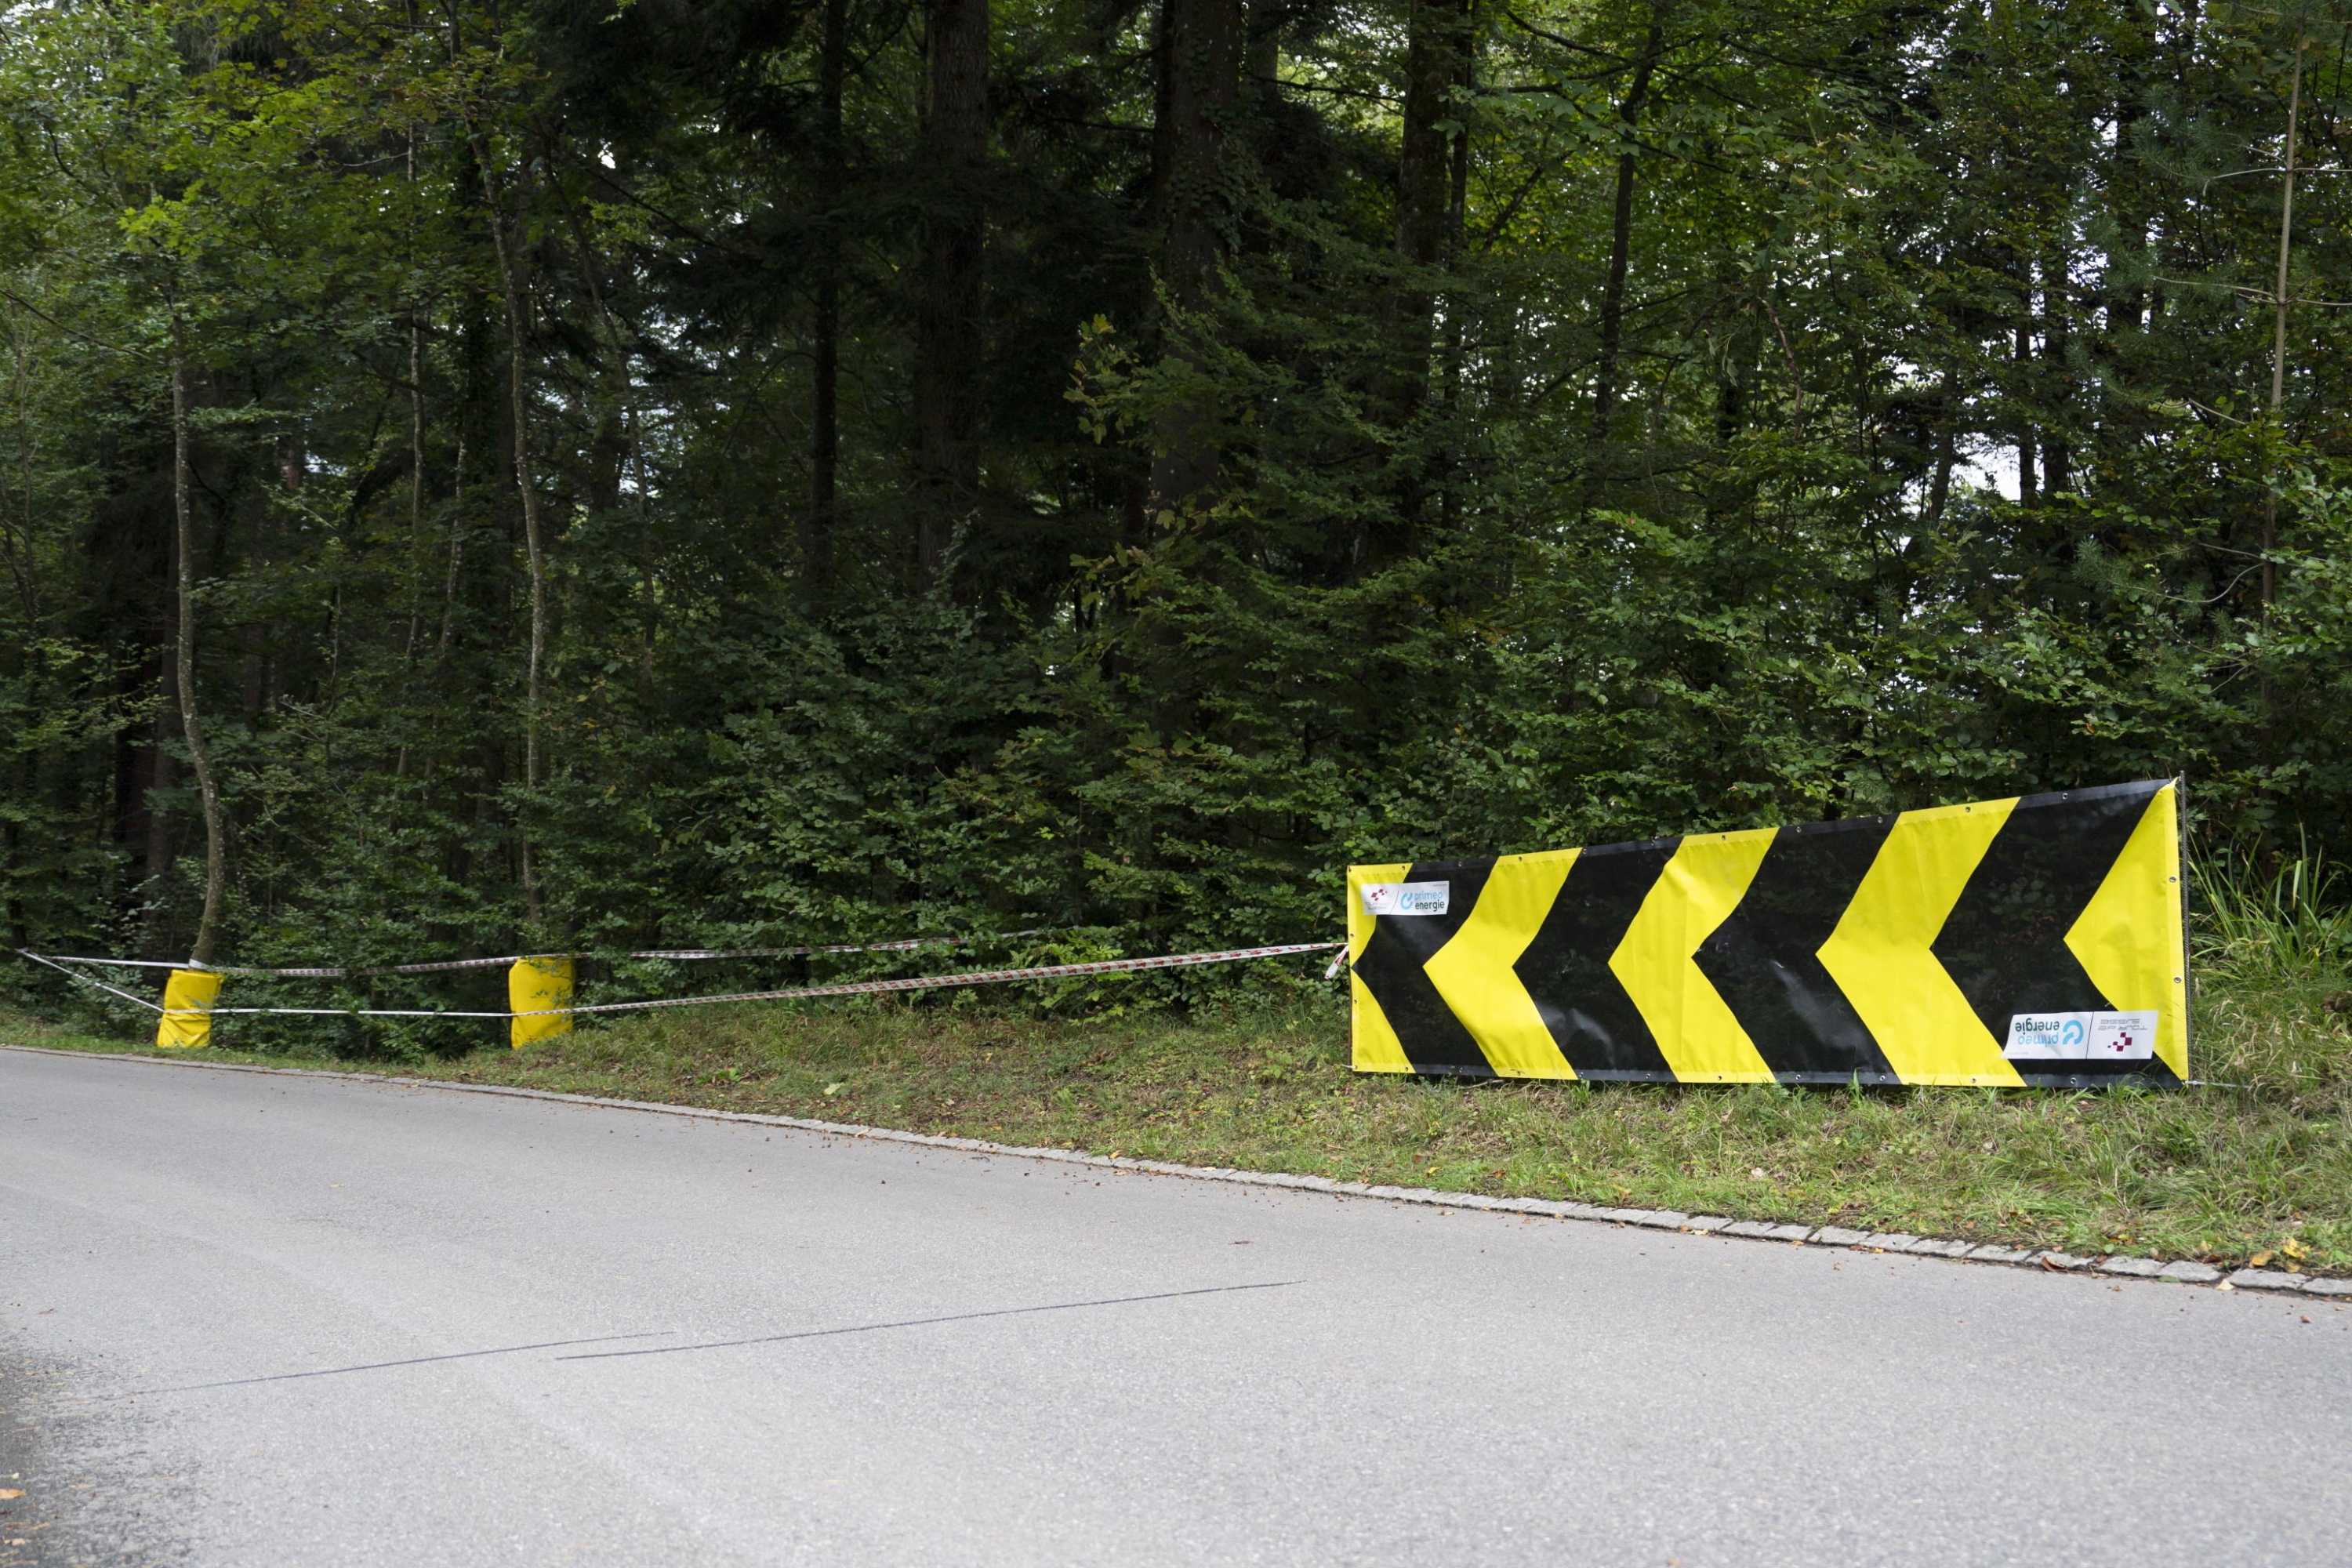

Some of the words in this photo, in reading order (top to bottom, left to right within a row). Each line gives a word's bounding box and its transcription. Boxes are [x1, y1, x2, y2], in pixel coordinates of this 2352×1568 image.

[1414, 891, 1443, 901] primeo
[1415, 899, 1445, 912] energie
[2015, 1018, 2060, 1035] energie
[2018, 1033, 2059, 1047] primeo
